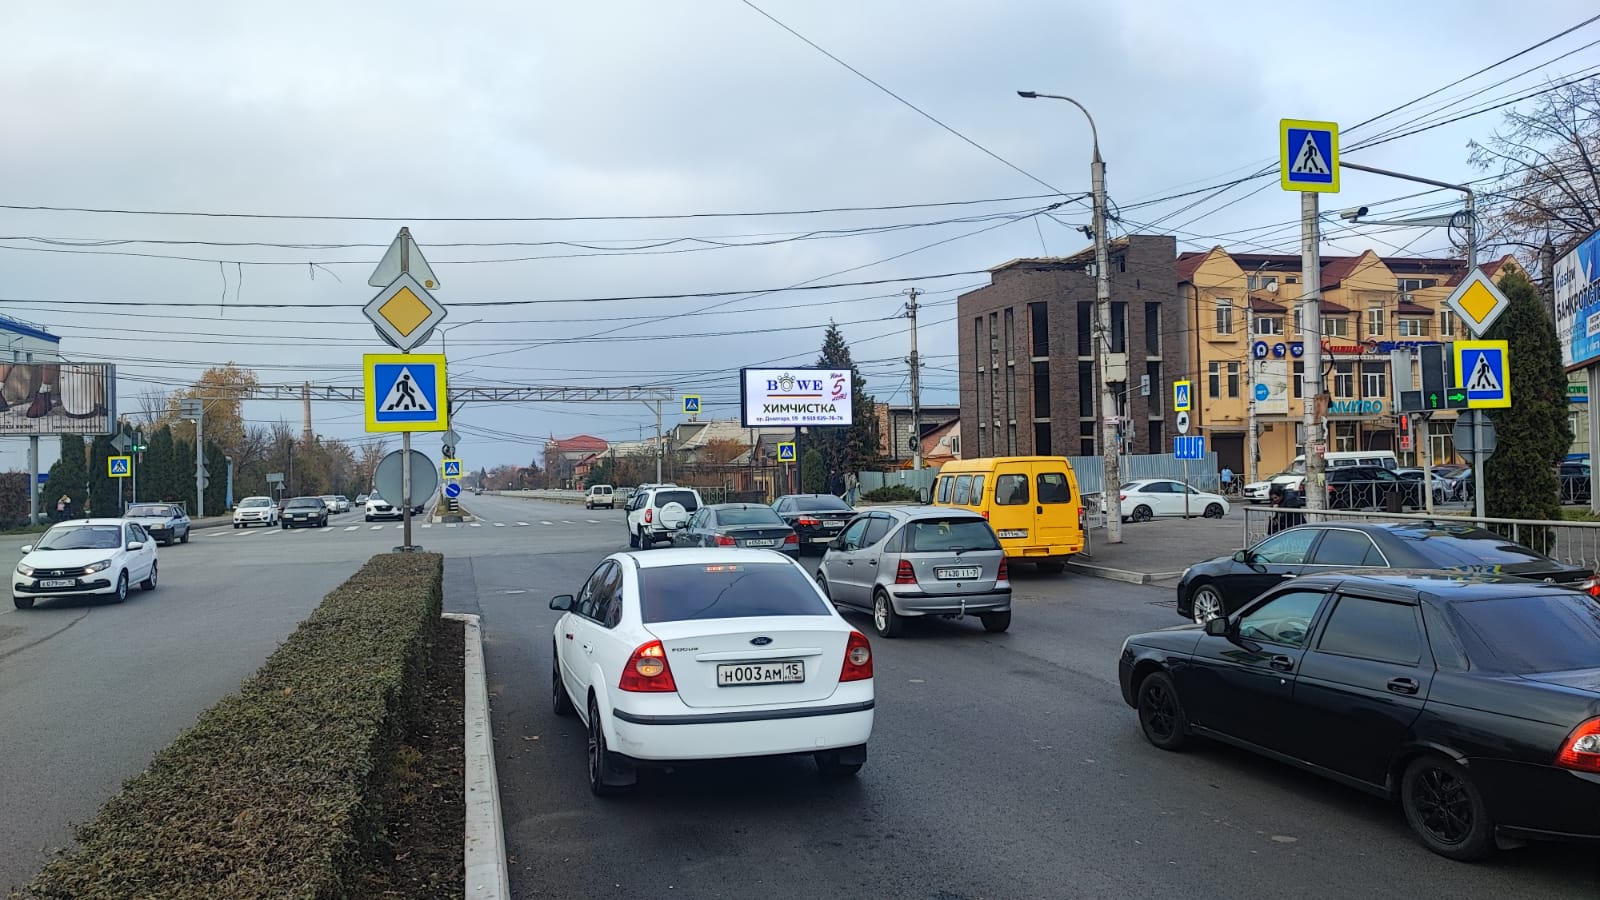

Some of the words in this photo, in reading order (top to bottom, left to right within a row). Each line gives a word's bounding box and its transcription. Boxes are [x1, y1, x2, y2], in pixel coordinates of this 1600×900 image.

[831, 378, 845, 395] 5
[763, 403, 836, 413] ХИМЧИСТКА
[786, 664, 799, 675] 15
